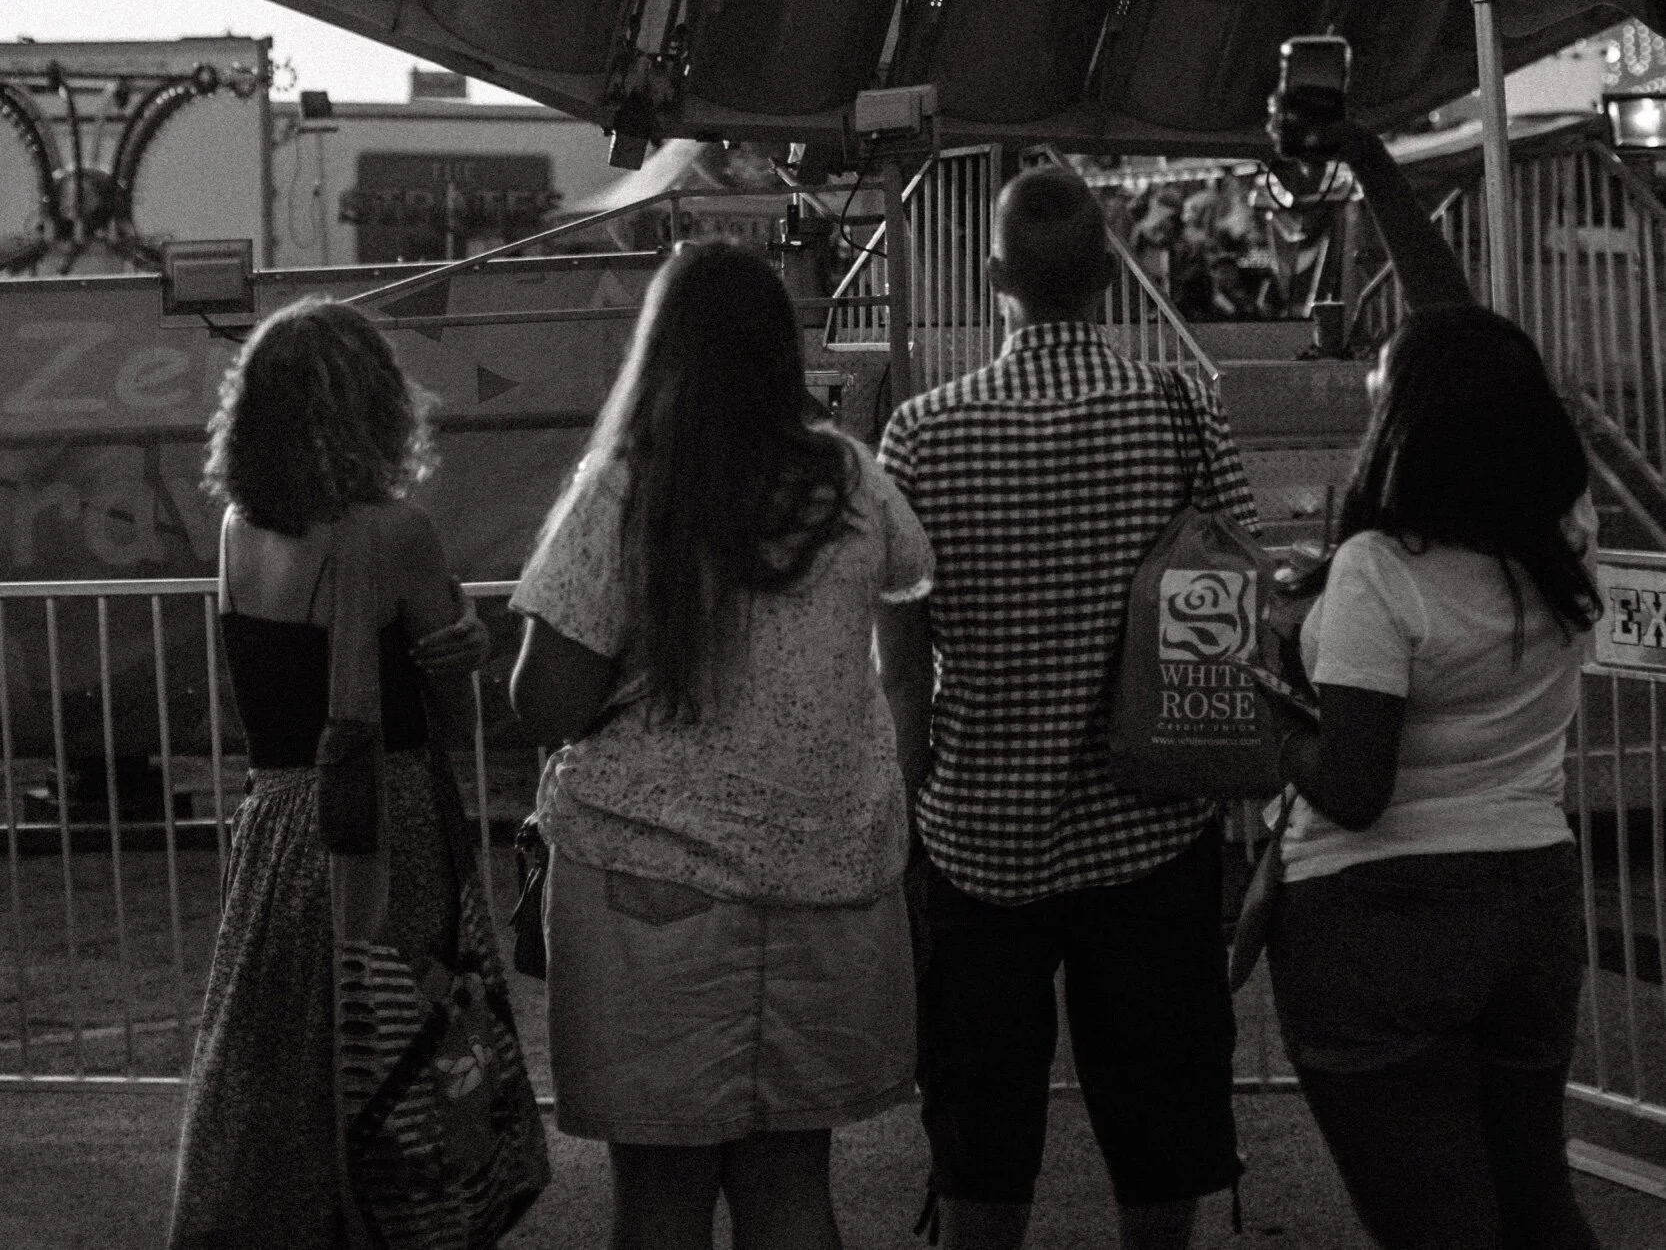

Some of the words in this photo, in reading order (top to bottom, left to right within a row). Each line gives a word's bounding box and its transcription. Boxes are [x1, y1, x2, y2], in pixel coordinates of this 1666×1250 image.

[1609, 586, 1666, 648] EX
[1159, 663, 1255, 687] WHITE
[1160, 690, 1255, 719] ROSE
